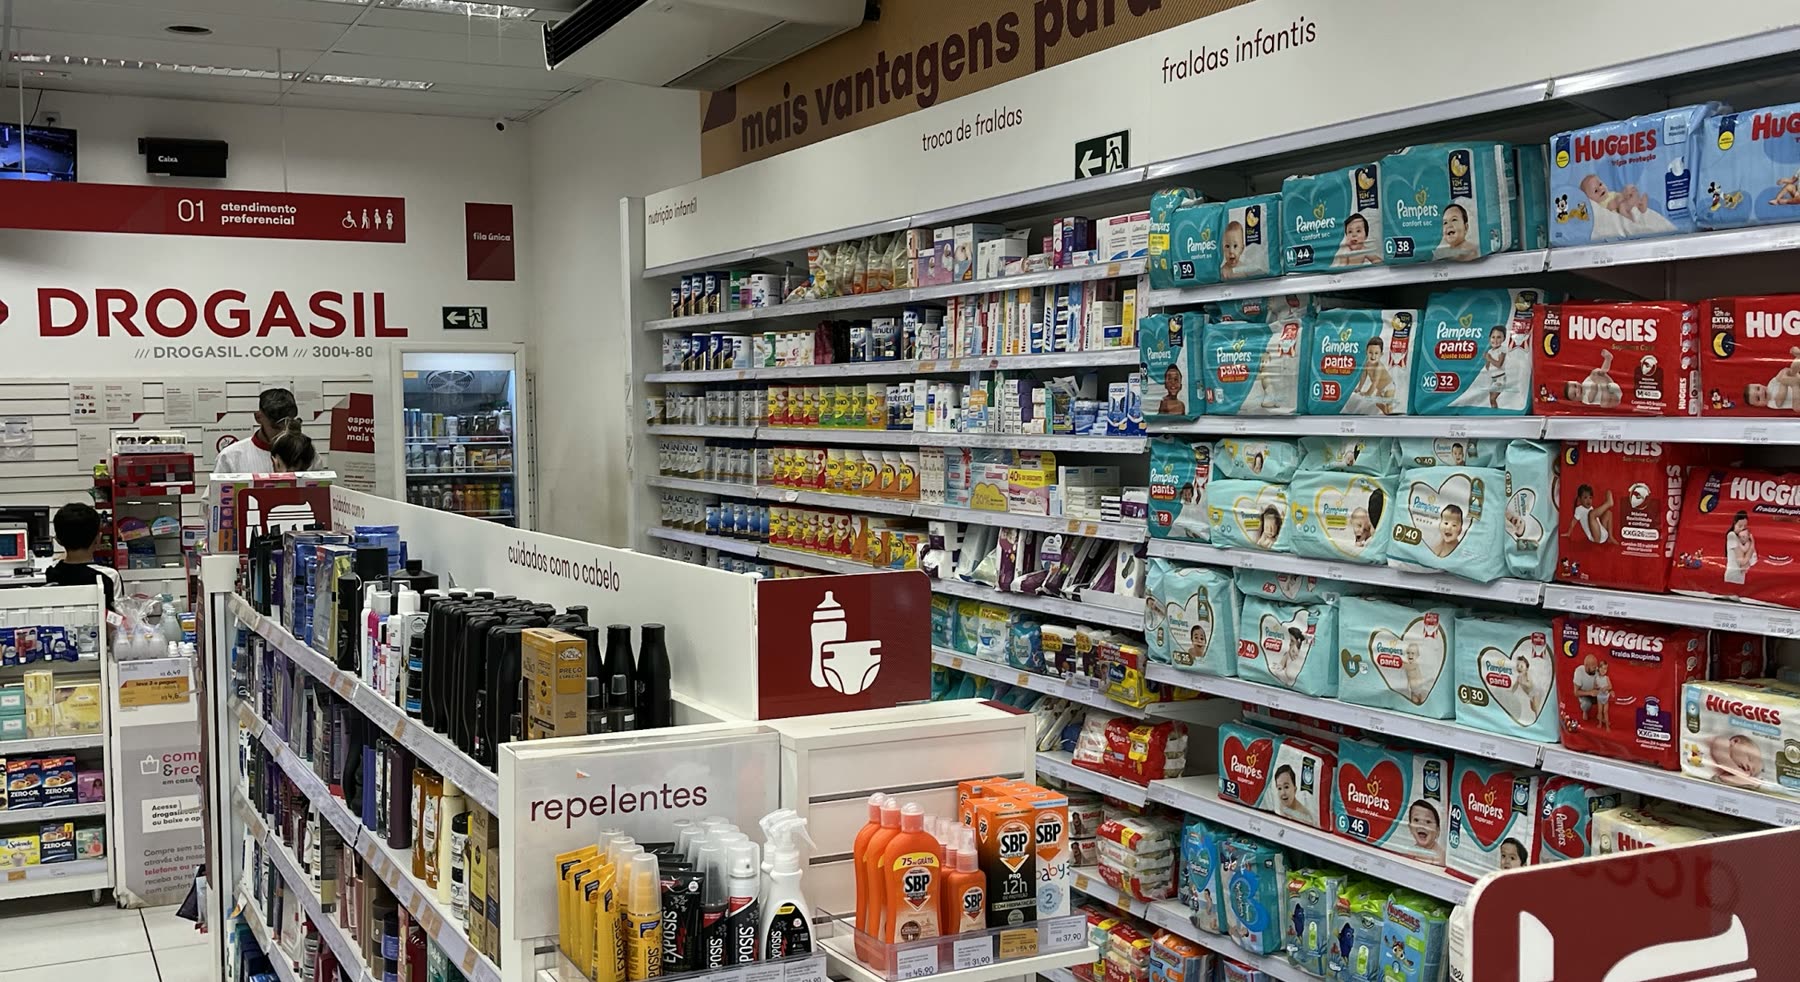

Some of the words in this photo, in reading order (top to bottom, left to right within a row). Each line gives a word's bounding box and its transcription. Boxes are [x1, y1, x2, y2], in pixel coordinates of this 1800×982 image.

[1161, 43, 1229, 84] fraldas
[1235, 16, 1317, 63] infantis
[741, 79, 807, 153] mais
[815, 12, 1019, 126] vantagens
[922, 131, 953, 152] troca
[956, 122, 972, 143] de
[975, 106, 1022, 141] fraldas
[1575, 129, 1657, 163] HUGGIES
[158, 155, 178, 164] Caixa
[178, 199, 206, 223] 01
[220, 202, 297, 214] atendimento
[648, 205, 674, 226] nutrição
[674, 197, 698, 217] infantil
[1396, 199, 1439, 220] Pampers
[221, 213, 295, 226] preferencial
[1296, 215, 1336, 234] Pampers
[473, 231, 486, 242] fila
[488, 231, 511, 242] única
[1386, 240, 1392, 253] G
[1397, 241, 1410, 251] 38
[1297, 249, 1310, 259] 44
[1182, 264, 1192, 274] 50
[37, 287, 409, 338] DROGASIL
[1712, 316, 1734, 324] EXTRA
[1745, 310, 1800, 338] HUG
[1437, 321, 1482, 340] Pampers
[1568, 315, 1657, 342] HUGGIES
[154, 345, 289, 359] DROGASIL.COM
[312, 346, 373, 358] 3004-80
[1321, 335, 1359, 356] Pampers
[1439, 341, 1474, 354] pants
[1147, 347, 1171, 361] Pampers
[1216, 347, 1251, 364] Pampers
[1324, 356, 1353, 368] pants
[1220, 364, 1248, 377] pants
[1423, 376, 1437, 387] XG
[1440, 376, 1453, 386] 32
[1313, 383, 1320, 395] G
[1324, 384, 1336, 395] 36
[1678, 378, 1687, 410] HUGGIES
[347, 425, 362, 433] ver
[347, 433, 369, 442] mais
[1587, 440, 1662, 457] HUGGIES
[1150, 468, 1179, 485] Pampers
[1151, 485, 1175, 495] pants
[1413, 496, 1441, 514] Pampers
[1665, 465, 1683, 558] HUGGIES
[1160, 513, 1168, 522] 28
[1396, 527, 1402, 538] P
[1406, 529, 1418, 540] 40
[1623, 529, 1637, 537] XXG
[508, 541, 548, 571] cuidados
[550, 556, 570, 579] com
[572, 564, 580, 581] o
[582, 558, 620, 592] cabelo
[1587, 625, 1664, 653] HUGGIES
[1246, 642, 1255, 653] 40
[1265, 642, 1281, 651] pants
[1377, 642, 1403, 656] Pampers
[1379, 657, 1400, 667] pants
[1630, 653, 1661, 661] Roupinha
[1486, 660, 1513, 675] Pampers
[1489, 676, 1509, 687] pants
[1461, 689, 1468, 699] G
[1471, 690, 1484, 700] 30
[1706, 694, 1781, 726] HUGGIES
[162, 751, 201, 763] com
[163, 764, 199, 777] &rec
[10, 789, 40, 798] ZERO-CAL
[45, 787, 74, 796] ZERO-CAL
[1226, 781, 1236, 794] 52
[1348, 783, 1390, 811] Pampers
[152, 804, 177, 812] Acesse
[530, 783, 708, 829] repelentes
[1468, 793, 1504, 820] Pampers
[1451, 807, 1461, 820] 40
[163, 817, 183, 825] baixe
[1338, 816, 1345, 828] G
[1351, 820, 1364, 832] 46
[1036, 823, 1062, 844] SBP
[1555, 813, 1567, 846] Pampers
[43, 841, 72, 850] ZERO-CAL
[1001, 832, 1028, 854] SBP
[144, 848, 175, 858] Compre
[176, 845, 193, 853] sem
[144, 857, 173, 867] através
[174, 855, 184, 863] de
[144, 864, 178, 876] telefone
[145, 876, 172, 886] receba
[173, 875, 183, 883] ou
[905, 874, 930, 893] SBP
[1002, 878, 1028, 896] 12h
[964, 893, 983, 909] SBP
[1045, 893, 1053, 904] 2
[663, 910, 683, 963] EXPOSIS
[1063, 933, 1081, 942] 37,90
[972, 956, 990, 965] 31,90
[913, 966, 934, 976] 45,90
